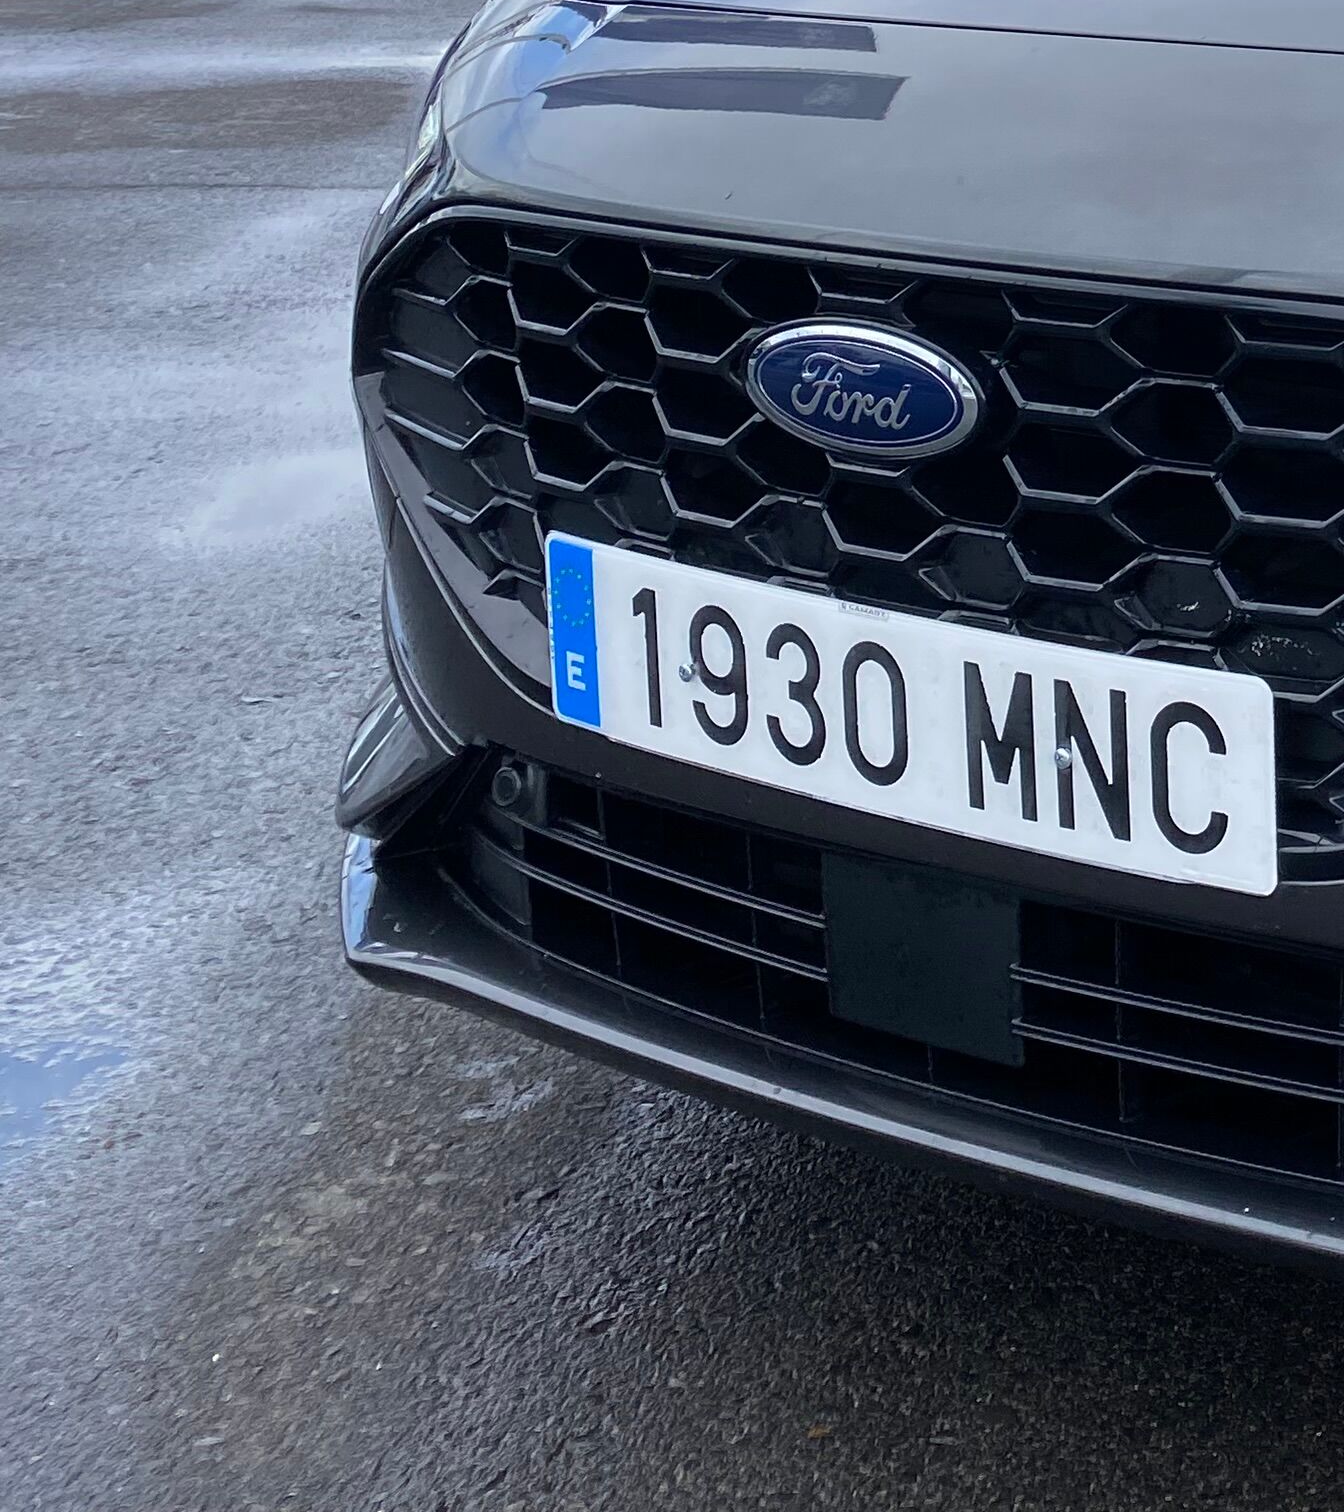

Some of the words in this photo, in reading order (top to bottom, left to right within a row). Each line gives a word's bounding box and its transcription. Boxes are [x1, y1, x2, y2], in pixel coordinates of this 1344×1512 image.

[790, 351, 912, 431] Ford
[565, 650, 587, 692] E
[632, 587, 909, 787] 1930
[963, 660, 1229, 855] MNC
